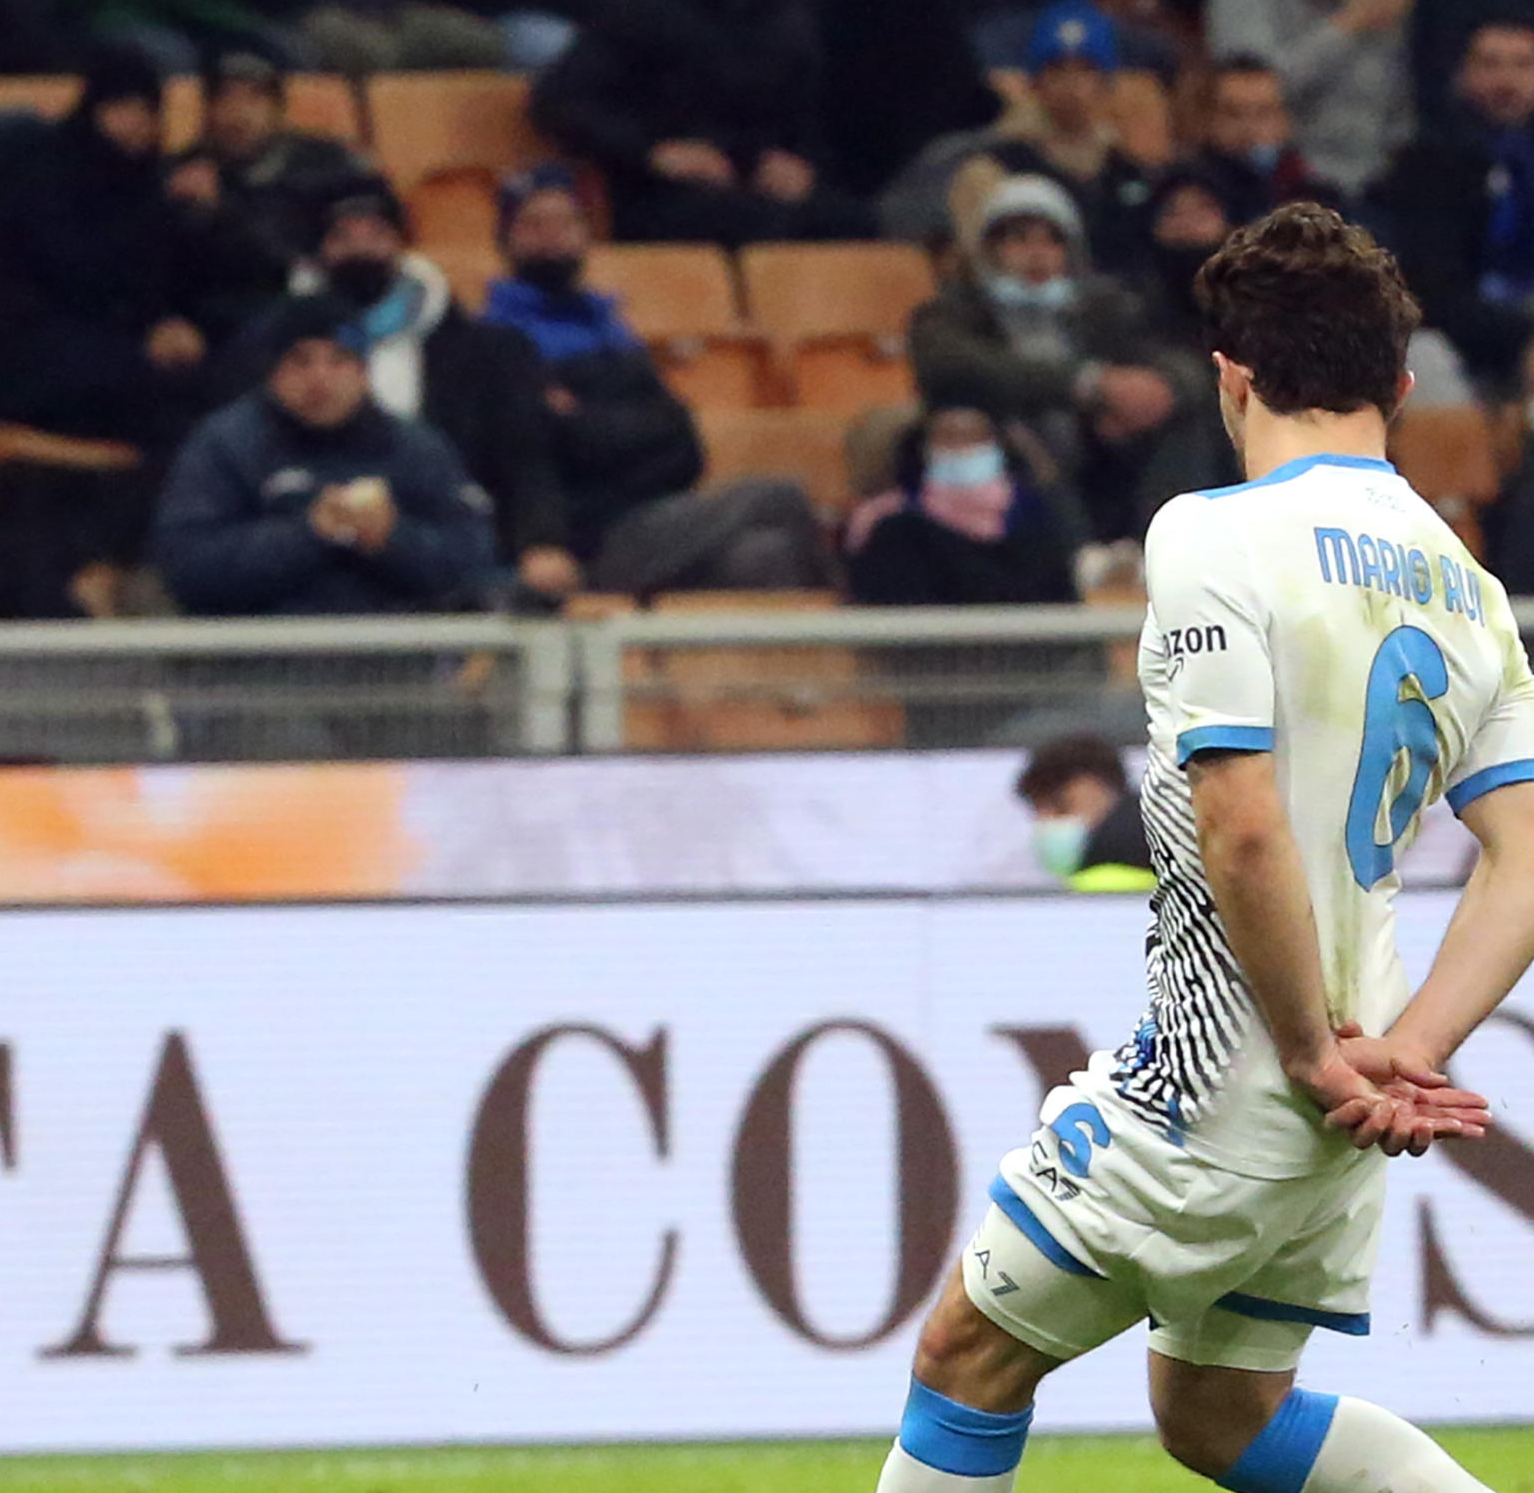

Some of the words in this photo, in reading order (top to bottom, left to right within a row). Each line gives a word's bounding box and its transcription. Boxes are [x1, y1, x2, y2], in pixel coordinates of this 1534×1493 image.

[1313, 526, 1432, 605] MARIO
[1345, 624, 1449, 893] 6
[1053, 1102, 1111, 1179] 6
[0, 1028, 311, 1358] A
[463, 1018, 1097, 1358] CO
[972, 1240, 1020, 1297] A7
